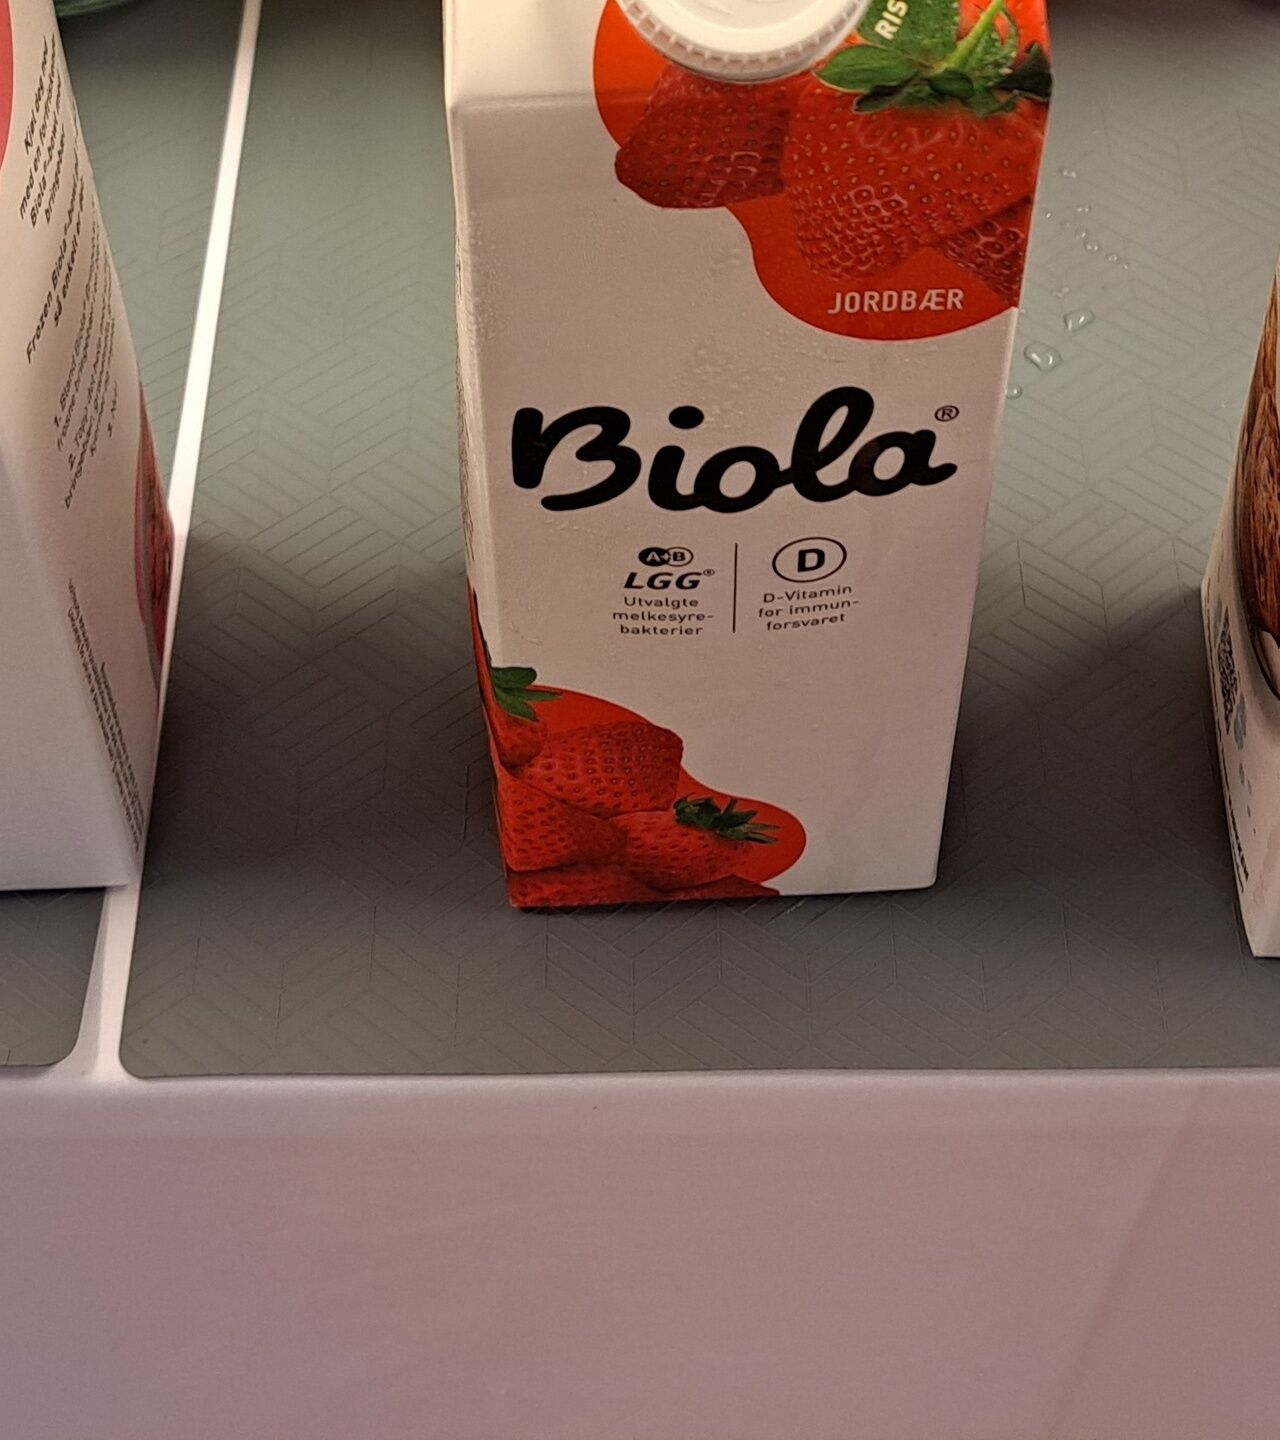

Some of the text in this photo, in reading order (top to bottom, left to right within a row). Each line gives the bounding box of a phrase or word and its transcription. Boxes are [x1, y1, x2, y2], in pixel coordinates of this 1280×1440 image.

[828, 289, 965, 315] JORDBÆR
[26, 291, 53, 364] Frozen
[511, 386, 958, 513] Biola
[797, 548, 826, 573] D
[624, 597, 700, 611] Utvalgte
[763, 585, 853, 604] D-Vitamin
[612, 611, 715, 624] melkesyre-
[758, 599, 860, 618] for immun-
[620, 624, 704, 636] bakterier
[766, 613, 846, 631] forsvaret
